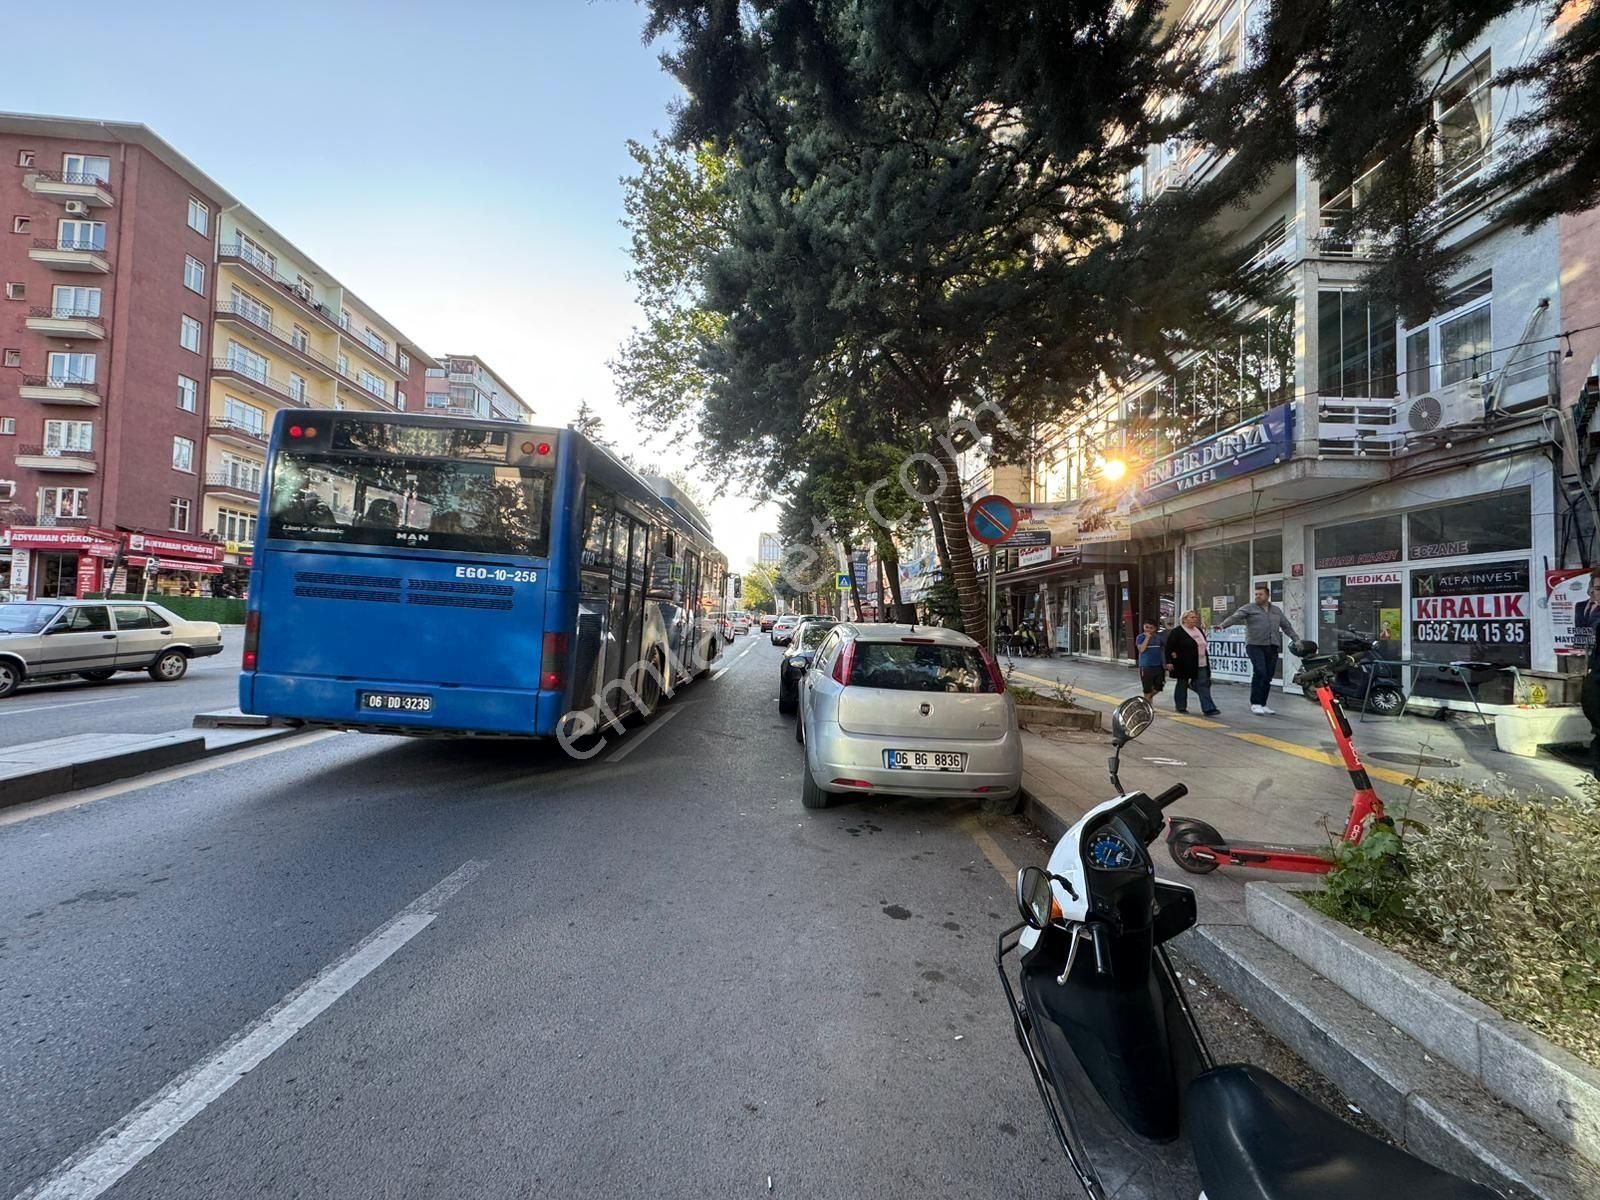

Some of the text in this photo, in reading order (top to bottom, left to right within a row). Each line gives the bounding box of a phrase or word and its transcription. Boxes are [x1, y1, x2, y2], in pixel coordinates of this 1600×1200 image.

[1174, 451, 1200, 475] BİR
[1202, 424, 1271, 463] DÜNYA
[12, 533, 59, 542] ADIYAMAN
[311, 526, 345, 534] Classic
[396, 532, 430, 542] MAN
[1411, 540, 1470, 559] ECZANE
[455, 566, 537, 583] EGO-10-258
[1439, 571, 1521, 586] ALFA INVEST
[1418, 622, 1524, 643] 0532 744 15 35
[1231, 660, 1238, 671] 15
[1240, 660, 1248, 673] 35
[369, 695, 430, 710] 06 DD 3239
[895, 752, 960, 767] 06 BG 8836
